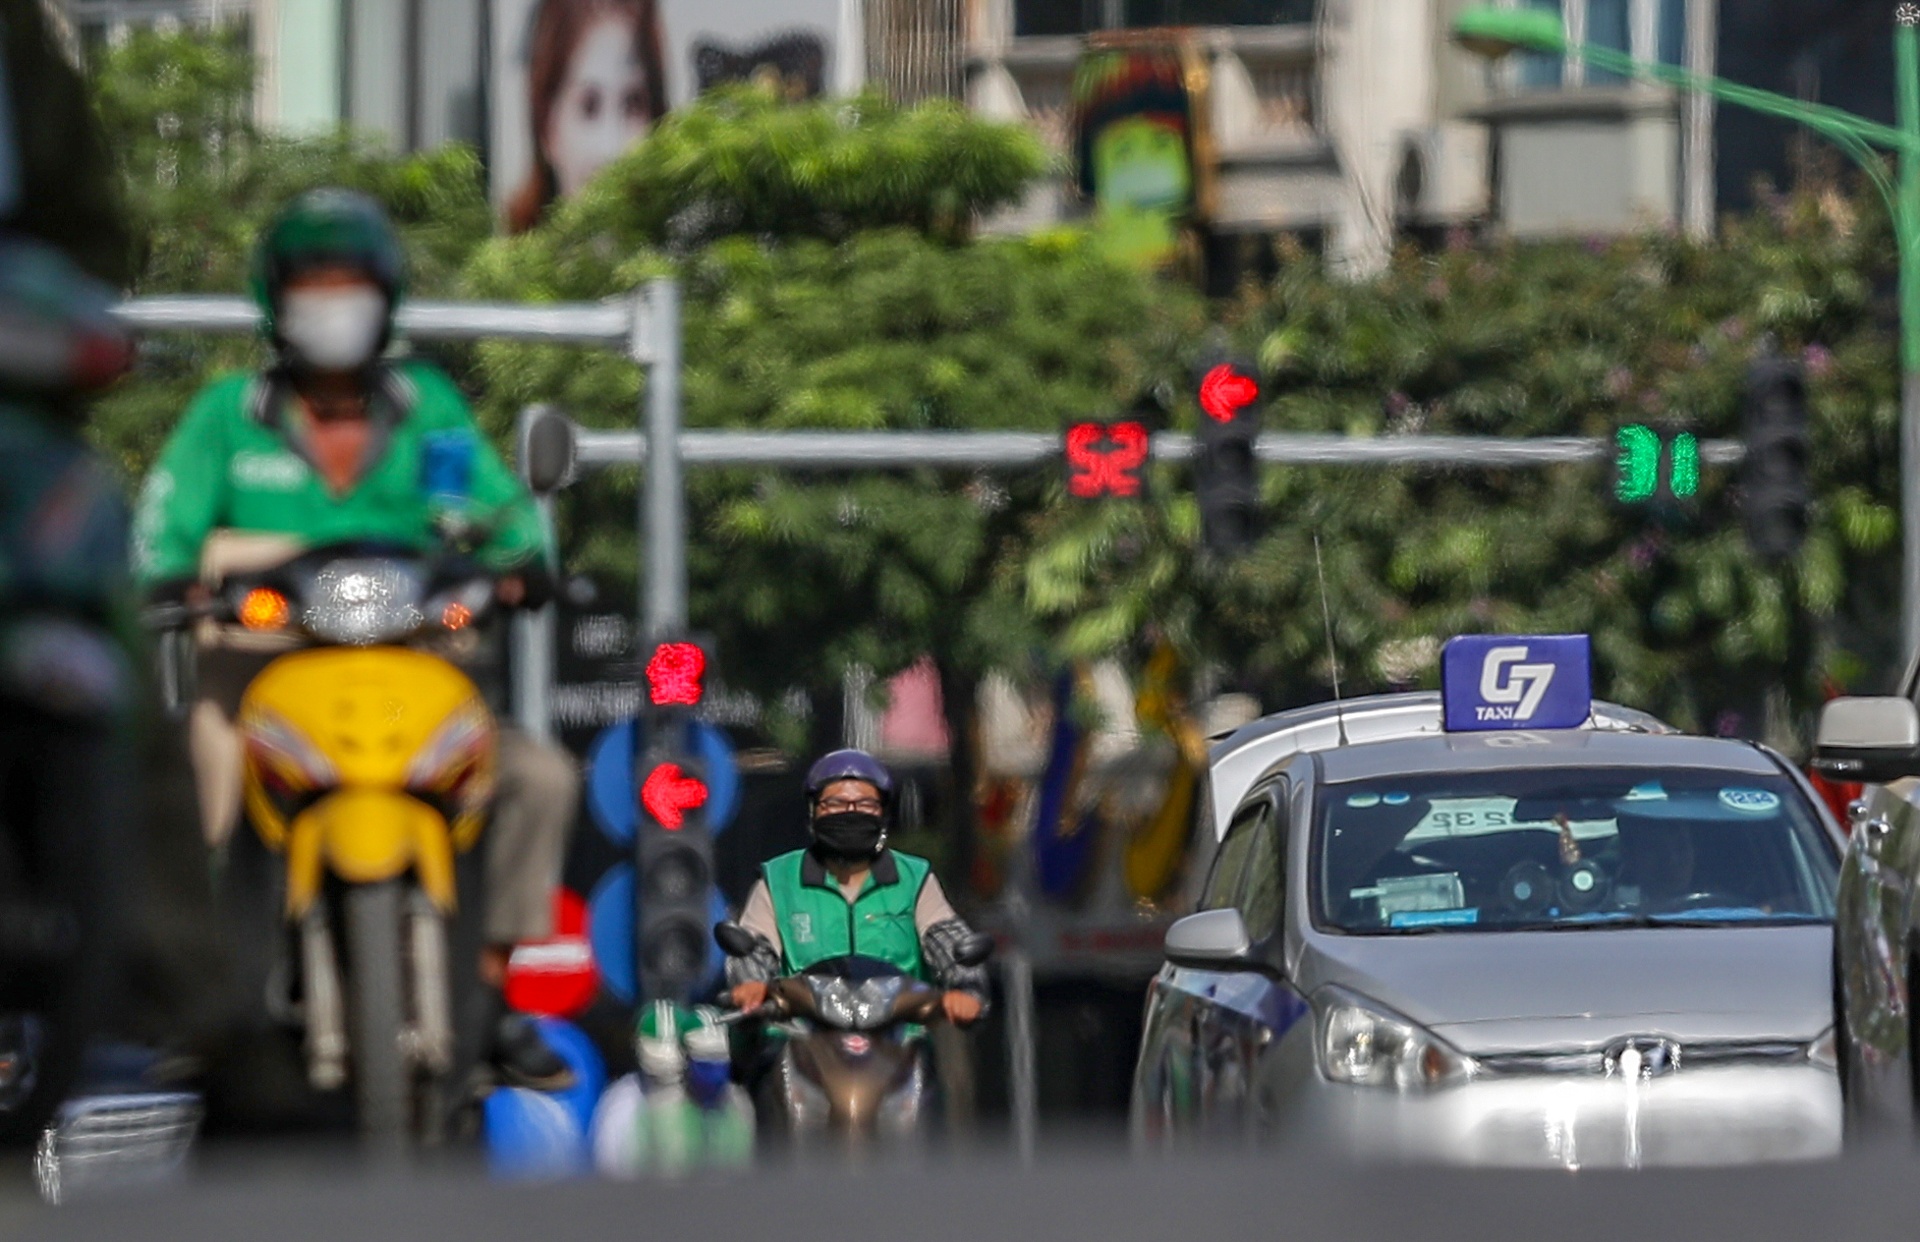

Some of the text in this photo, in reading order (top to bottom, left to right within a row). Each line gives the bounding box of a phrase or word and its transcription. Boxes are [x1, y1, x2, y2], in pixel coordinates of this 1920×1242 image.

[1066, 421, 1148, 498] 52
[1475, 706, 1514, 721] TAXI
[1480, 646, 1556, 720] G7
